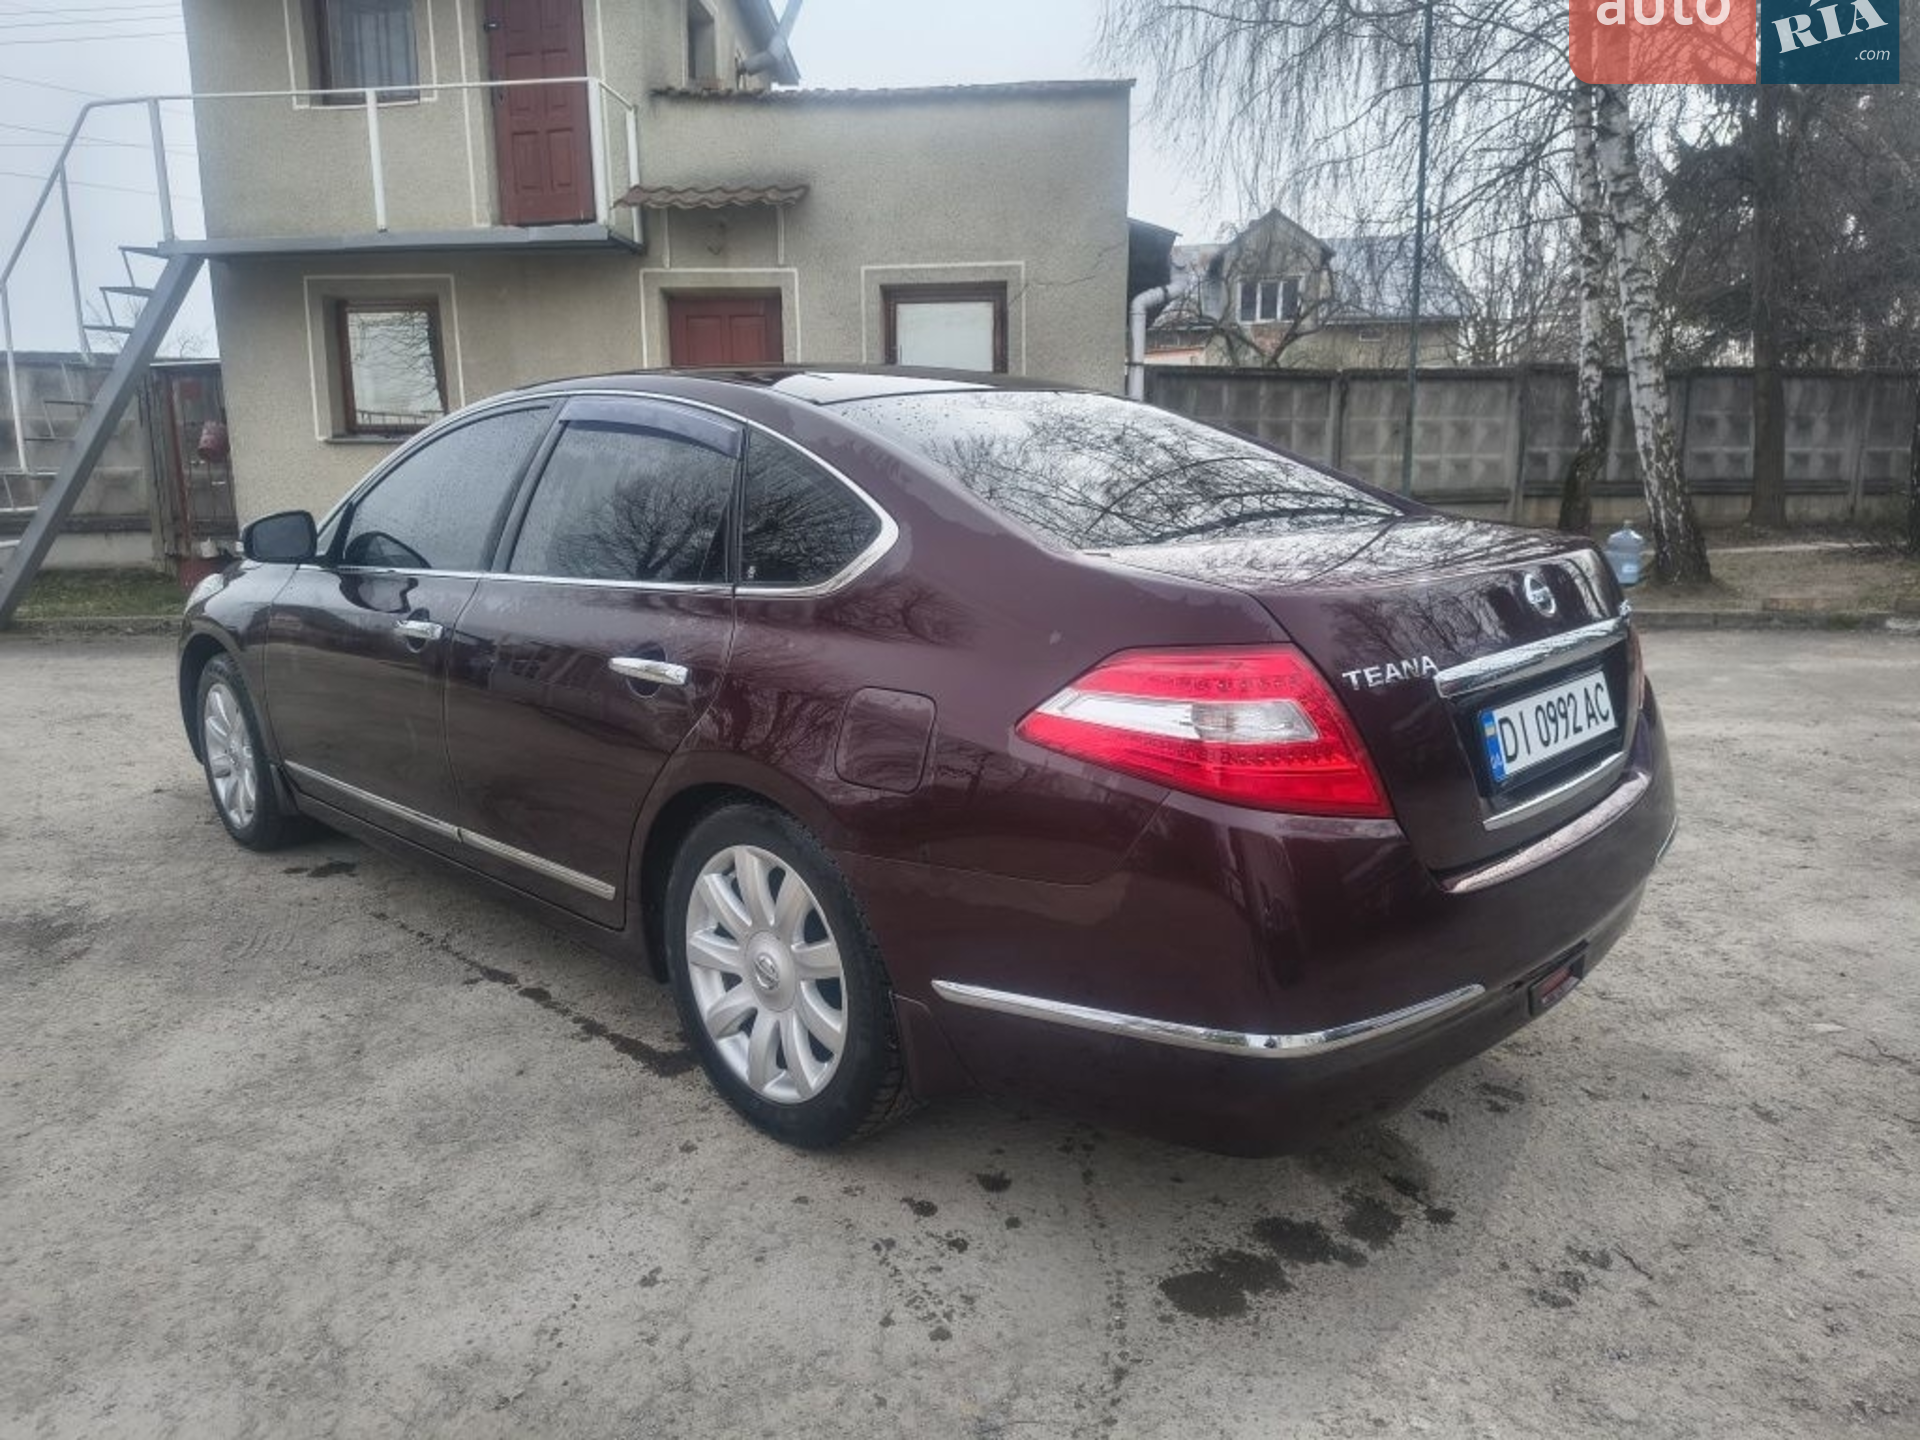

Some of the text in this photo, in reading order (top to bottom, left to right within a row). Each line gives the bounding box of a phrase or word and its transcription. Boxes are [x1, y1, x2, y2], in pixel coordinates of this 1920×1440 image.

[1342, 655, 1439, 690] TEANA
[1498, 682, 1610, 764] DI 0992 AC
